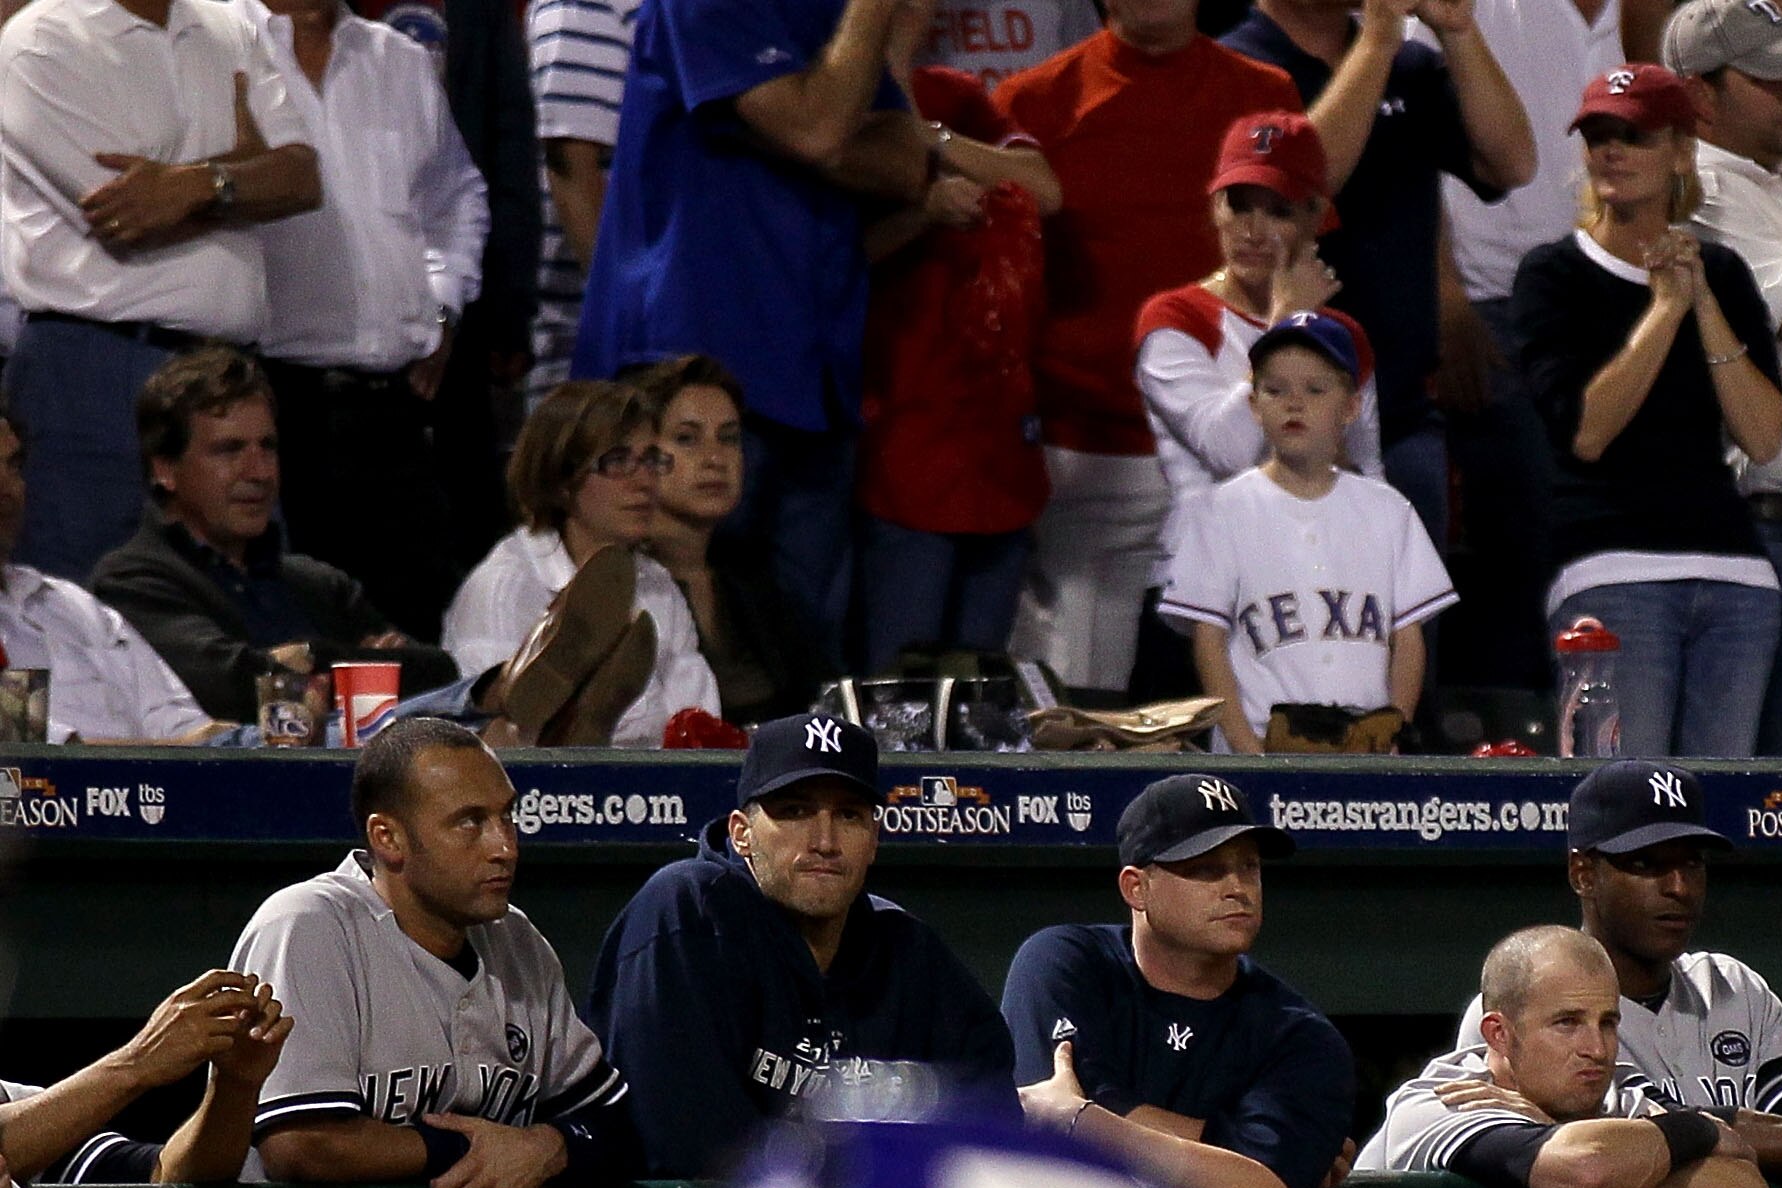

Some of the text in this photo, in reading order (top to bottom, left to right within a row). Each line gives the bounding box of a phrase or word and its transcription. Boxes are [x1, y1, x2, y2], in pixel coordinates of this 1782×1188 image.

[1239, 588, 1386, 656] TEXA
[804, 717, 842, 753] NY
[86, 787, 131, 817] FOX
[138, 784, 166, 803] tbs
[1197, 779, 1239, 811] NY
[1648, 771, 1687, 807] NY
[1018, 795, 1059, 824] FOX
[1066, 792, 1092, 811] tbs
[1270, 793, 1568, 841] texasrangers.com
[1166, 1022, 1194, 1051] NY
